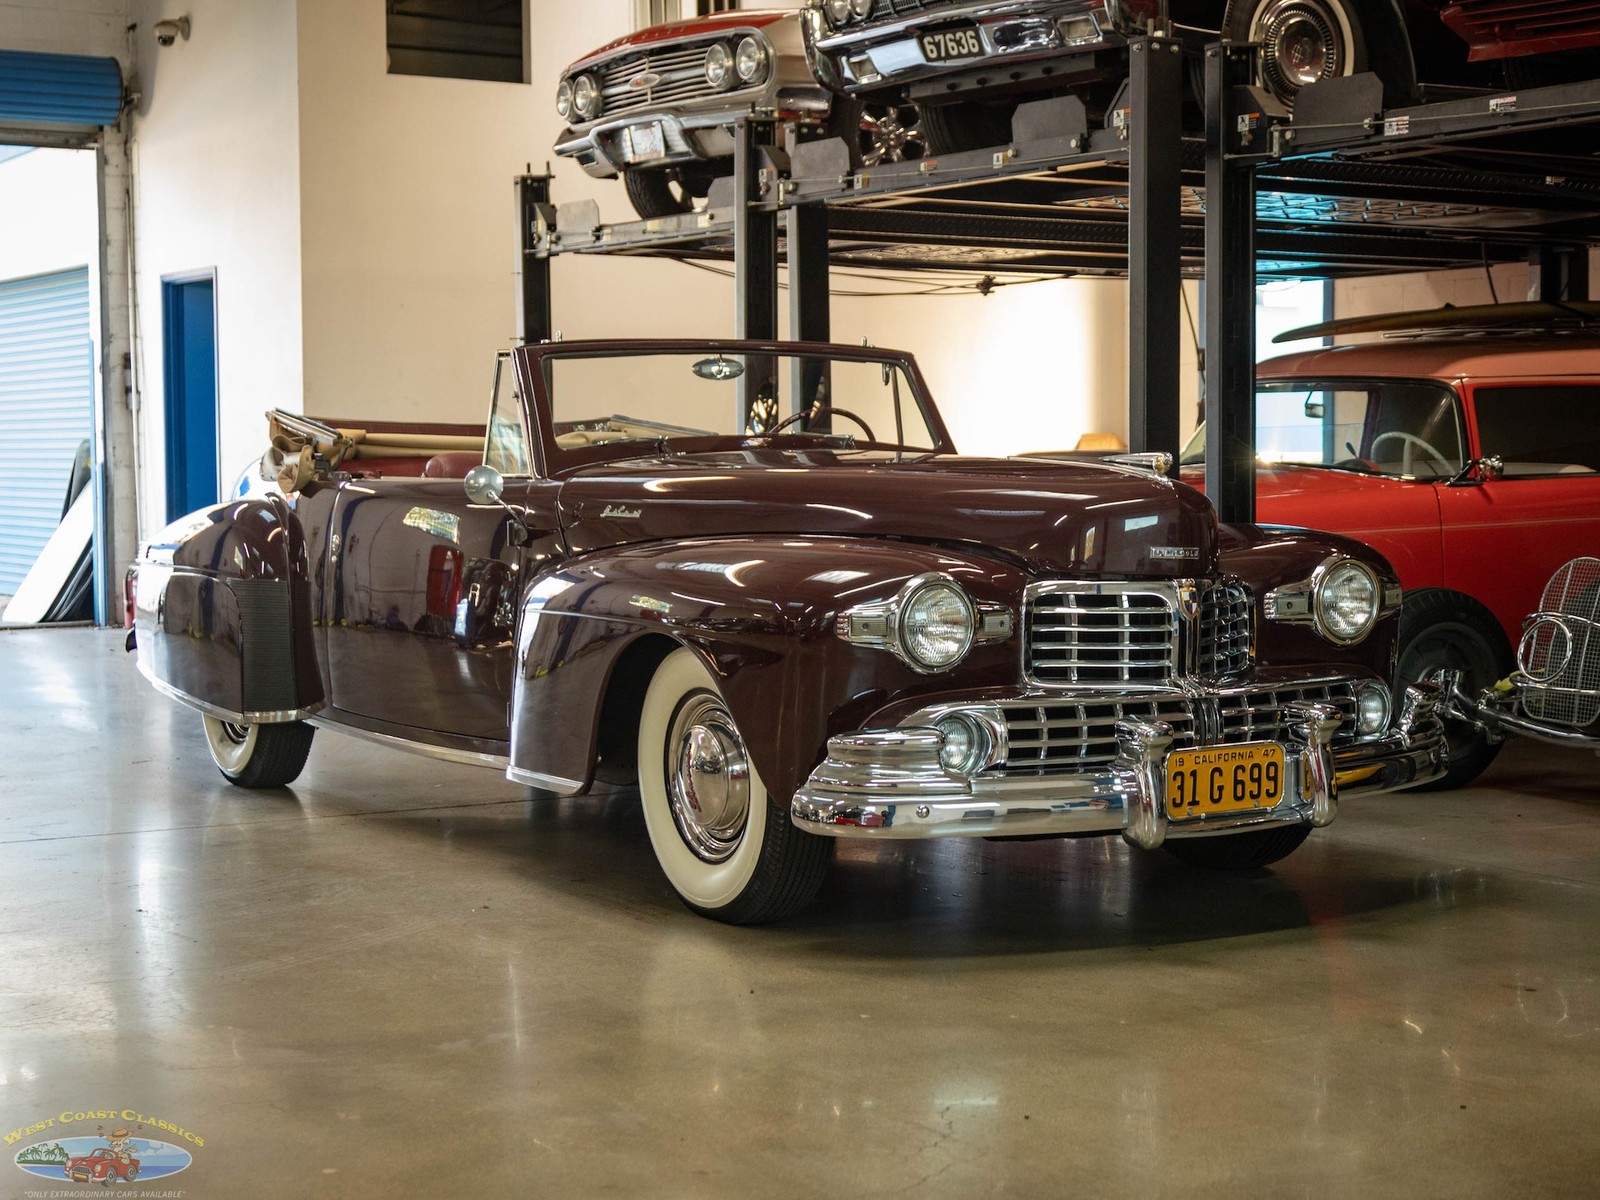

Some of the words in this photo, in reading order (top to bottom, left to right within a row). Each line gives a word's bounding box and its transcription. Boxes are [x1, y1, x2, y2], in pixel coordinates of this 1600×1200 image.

[923, 30, 979, 58] 67636
[1175, 757, 1185, 767] 19
[1194, 750, 1254, 765] CALIFORNIA
[1262, 748, 1276, 758] 47
[1172, 769, 1200, 808] 31
[1209, 766, 1225, 804] G
[1232, 761, 1279, 801] 699
